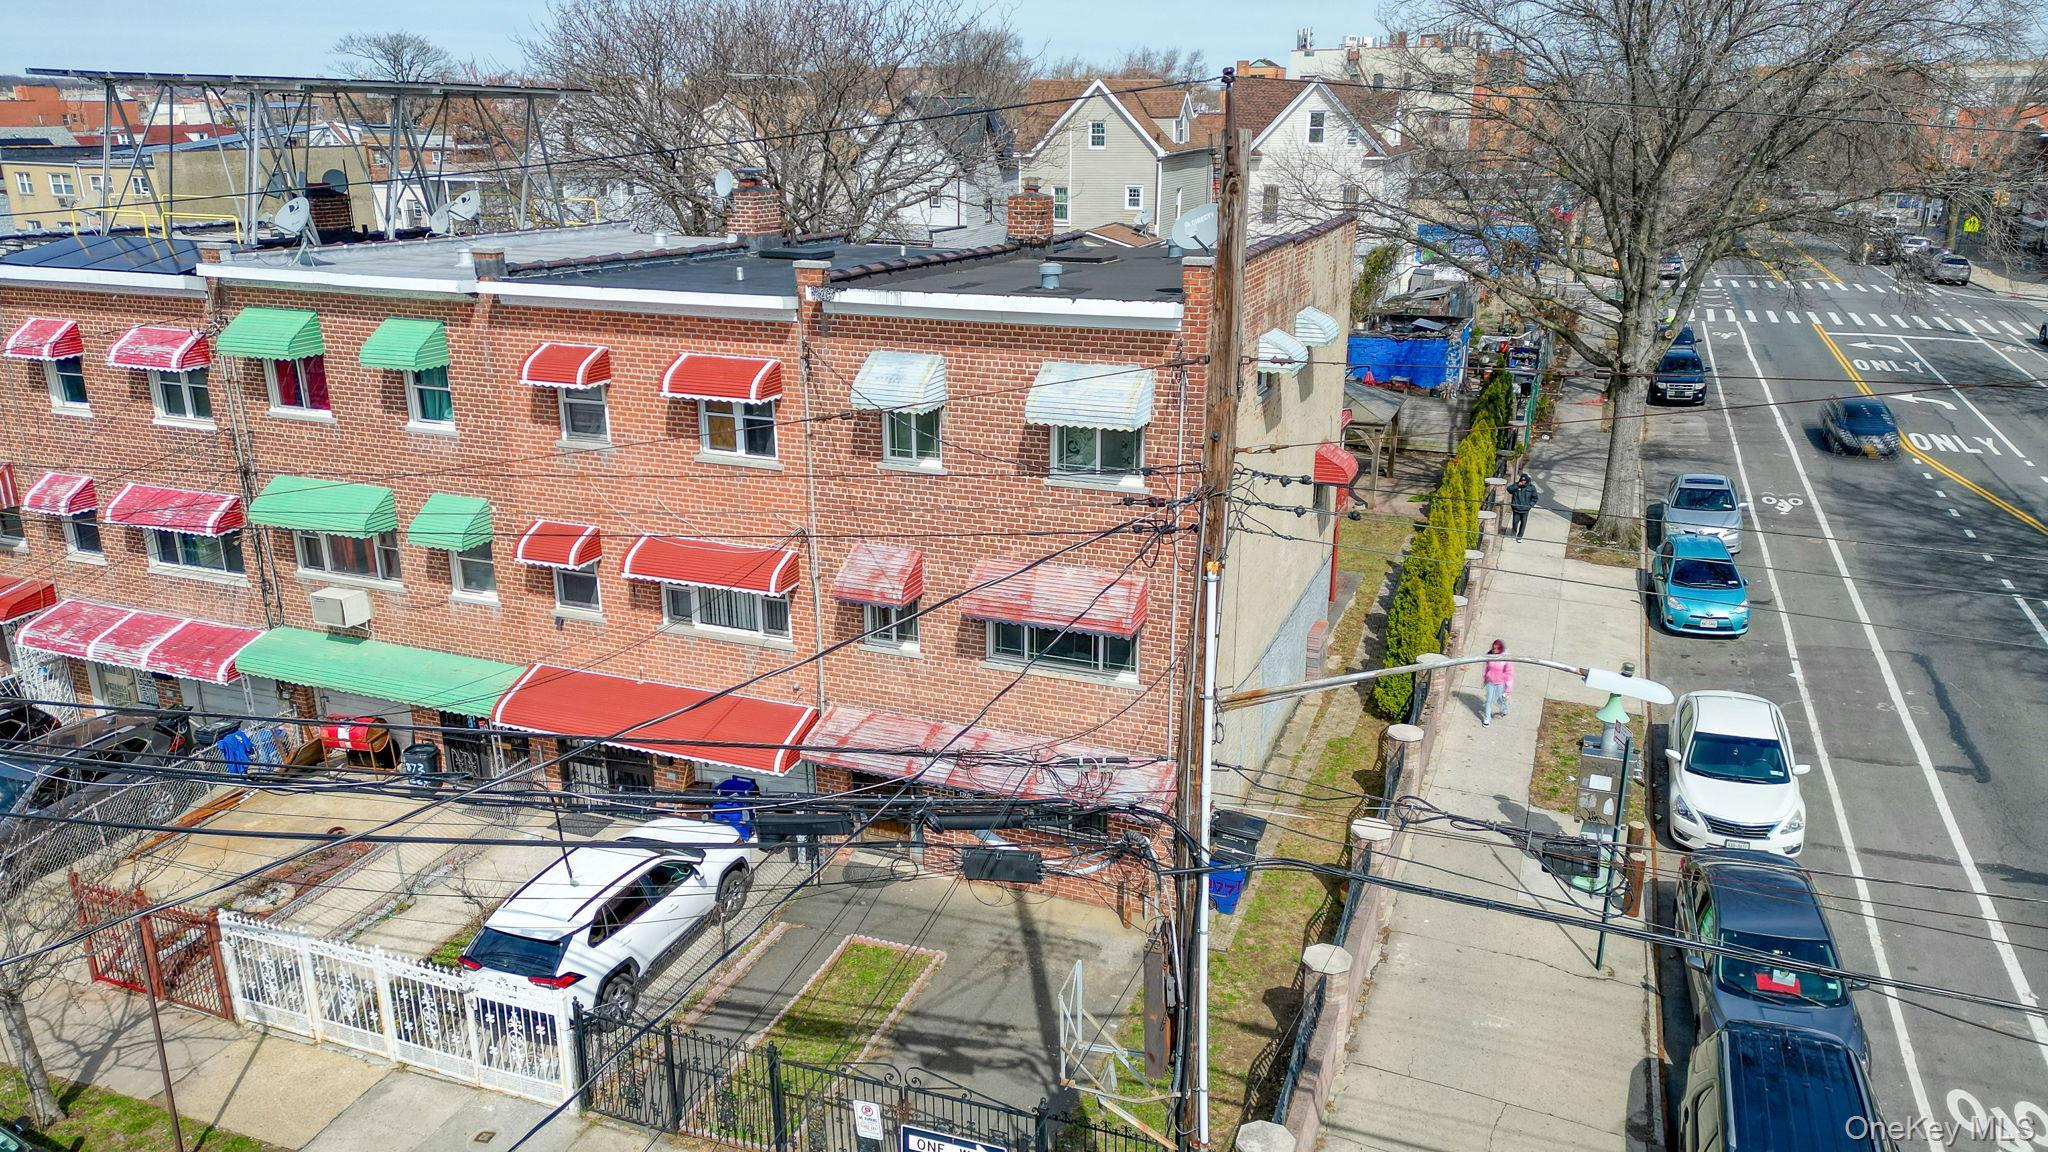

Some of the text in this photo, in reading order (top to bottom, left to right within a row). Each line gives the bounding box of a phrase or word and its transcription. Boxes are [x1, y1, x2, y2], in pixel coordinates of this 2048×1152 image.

[1852, 359, 1925, 374] ONLY
[1907, 432, 2002, 456] ONLY
[917, 1139, 945, 1152] ONE
